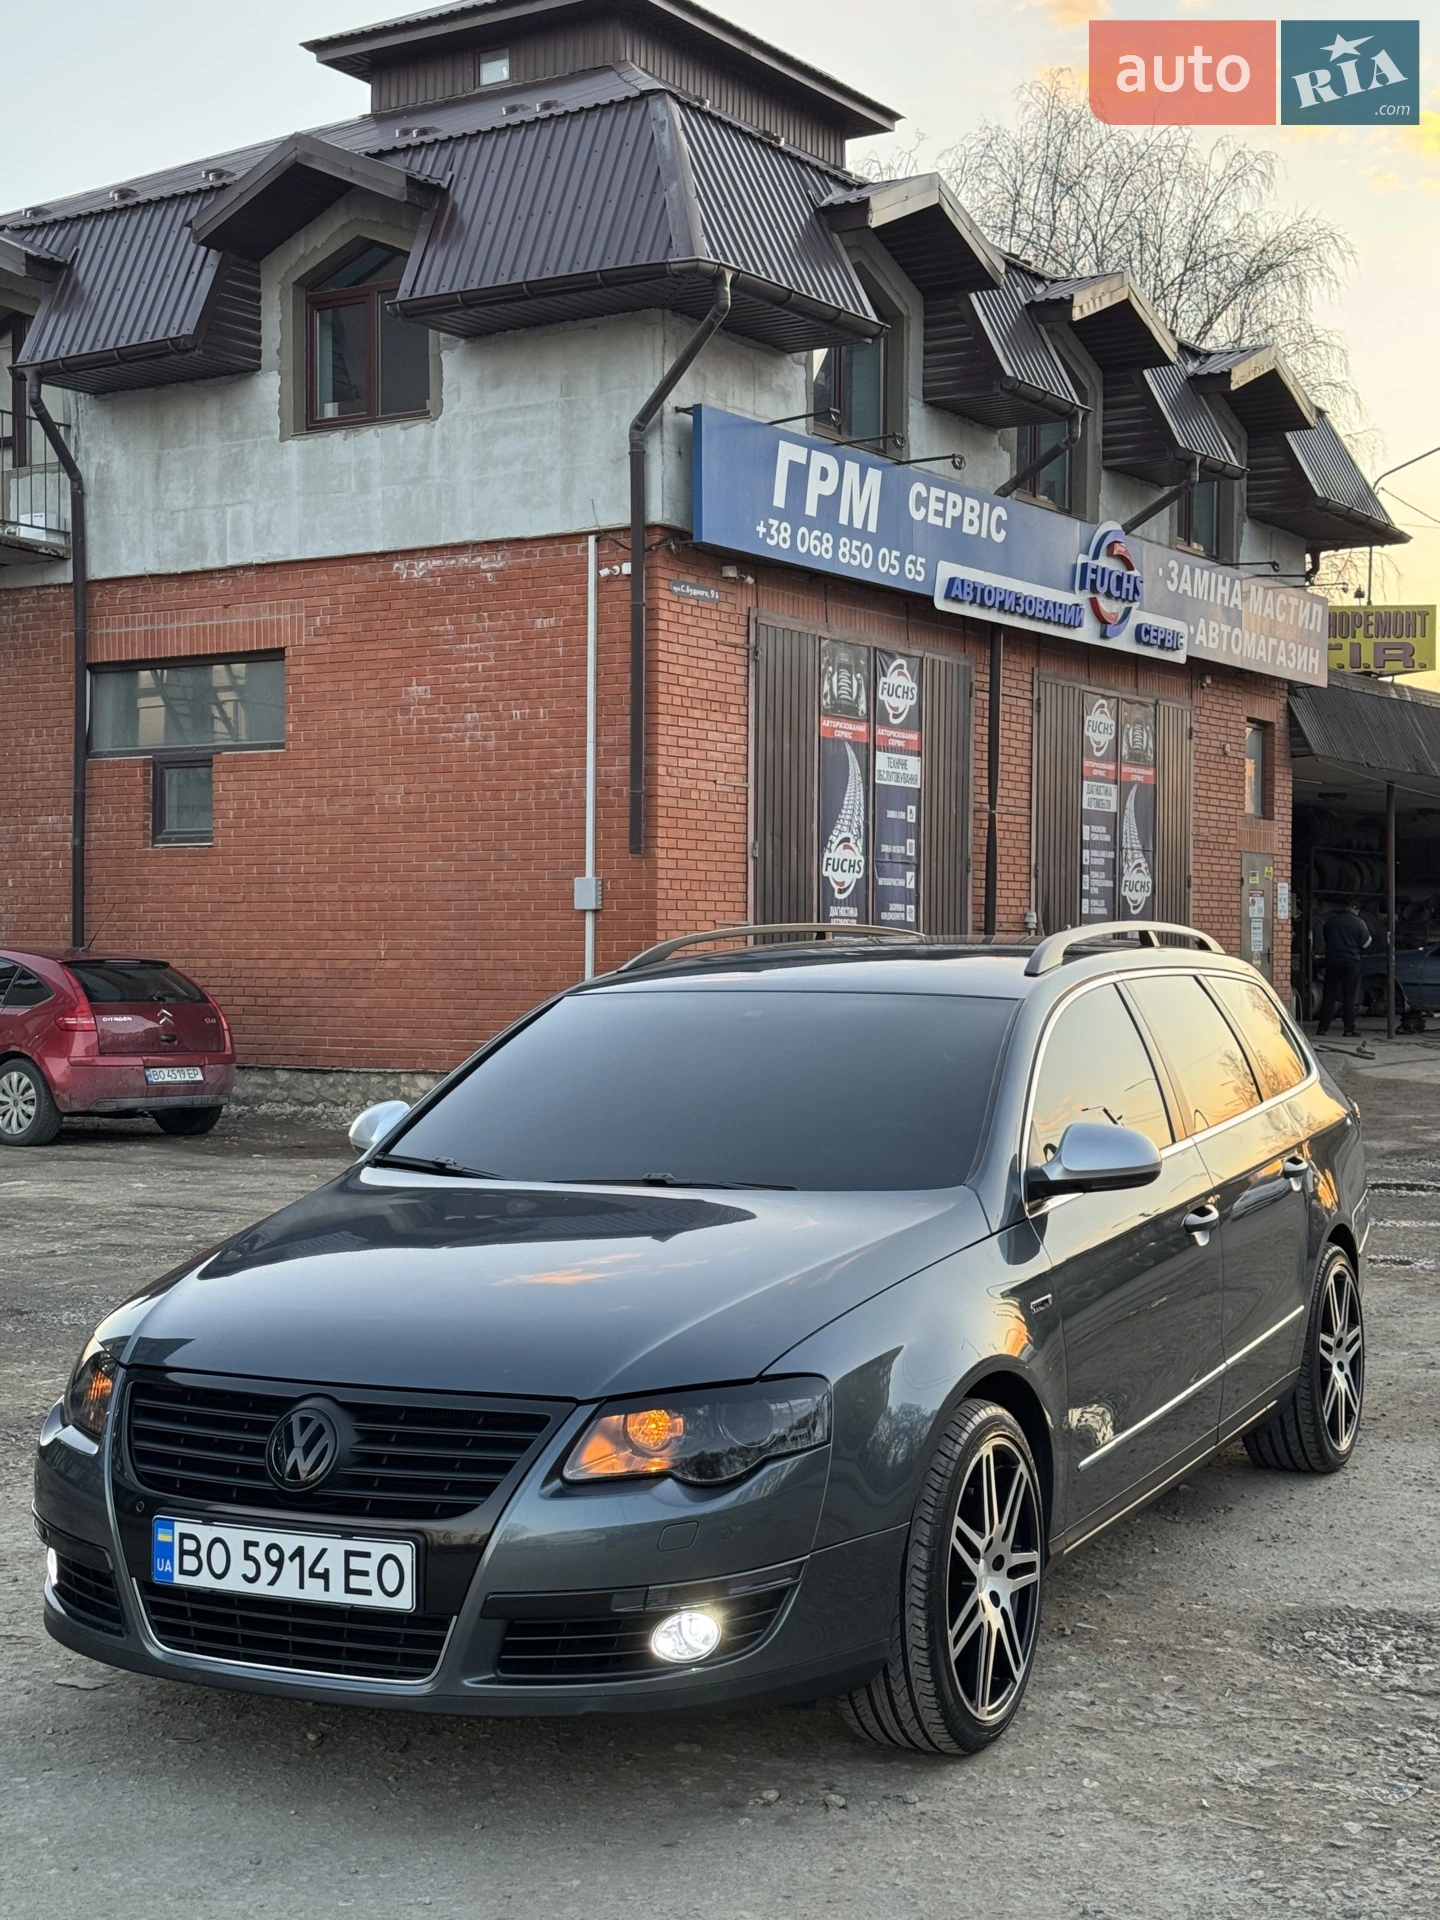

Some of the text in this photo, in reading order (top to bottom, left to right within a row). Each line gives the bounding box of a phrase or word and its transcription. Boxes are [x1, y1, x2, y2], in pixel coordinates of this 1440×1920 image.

[773, 440, 1008, 543] ГРМ СЕРВІС
[756, 518, 926, 582] +38 068 850 05 65
[1083, 562, 1144, 602] FUCHS
[948, 577, 1085, 627] АВТОРИЗОВАНИЙ
[1166, 559, 1323, 633] ЗАМІНА МАСТИЛ
[1138, 623, 1185, 650] СЕРВІС
[1195, 617, 1320, 675] АВТОМАГАЗИН
[1328, 641, 1427, 669] .I.R.
[880, 681, 916, 701] FUCHS
[834, 730, 853, 739] СЕРВІС
[1087, 719, 1114, 736] FUCHS
[824, 857, 862, 875] FUCHS
[1123, 880, 1150, 893] FUCHS
[167, 1069, 186, 1079] 4519
[157, 1558, 172, 1573] UA
[178, 1532, 405, 1598] BO 5914 EO
